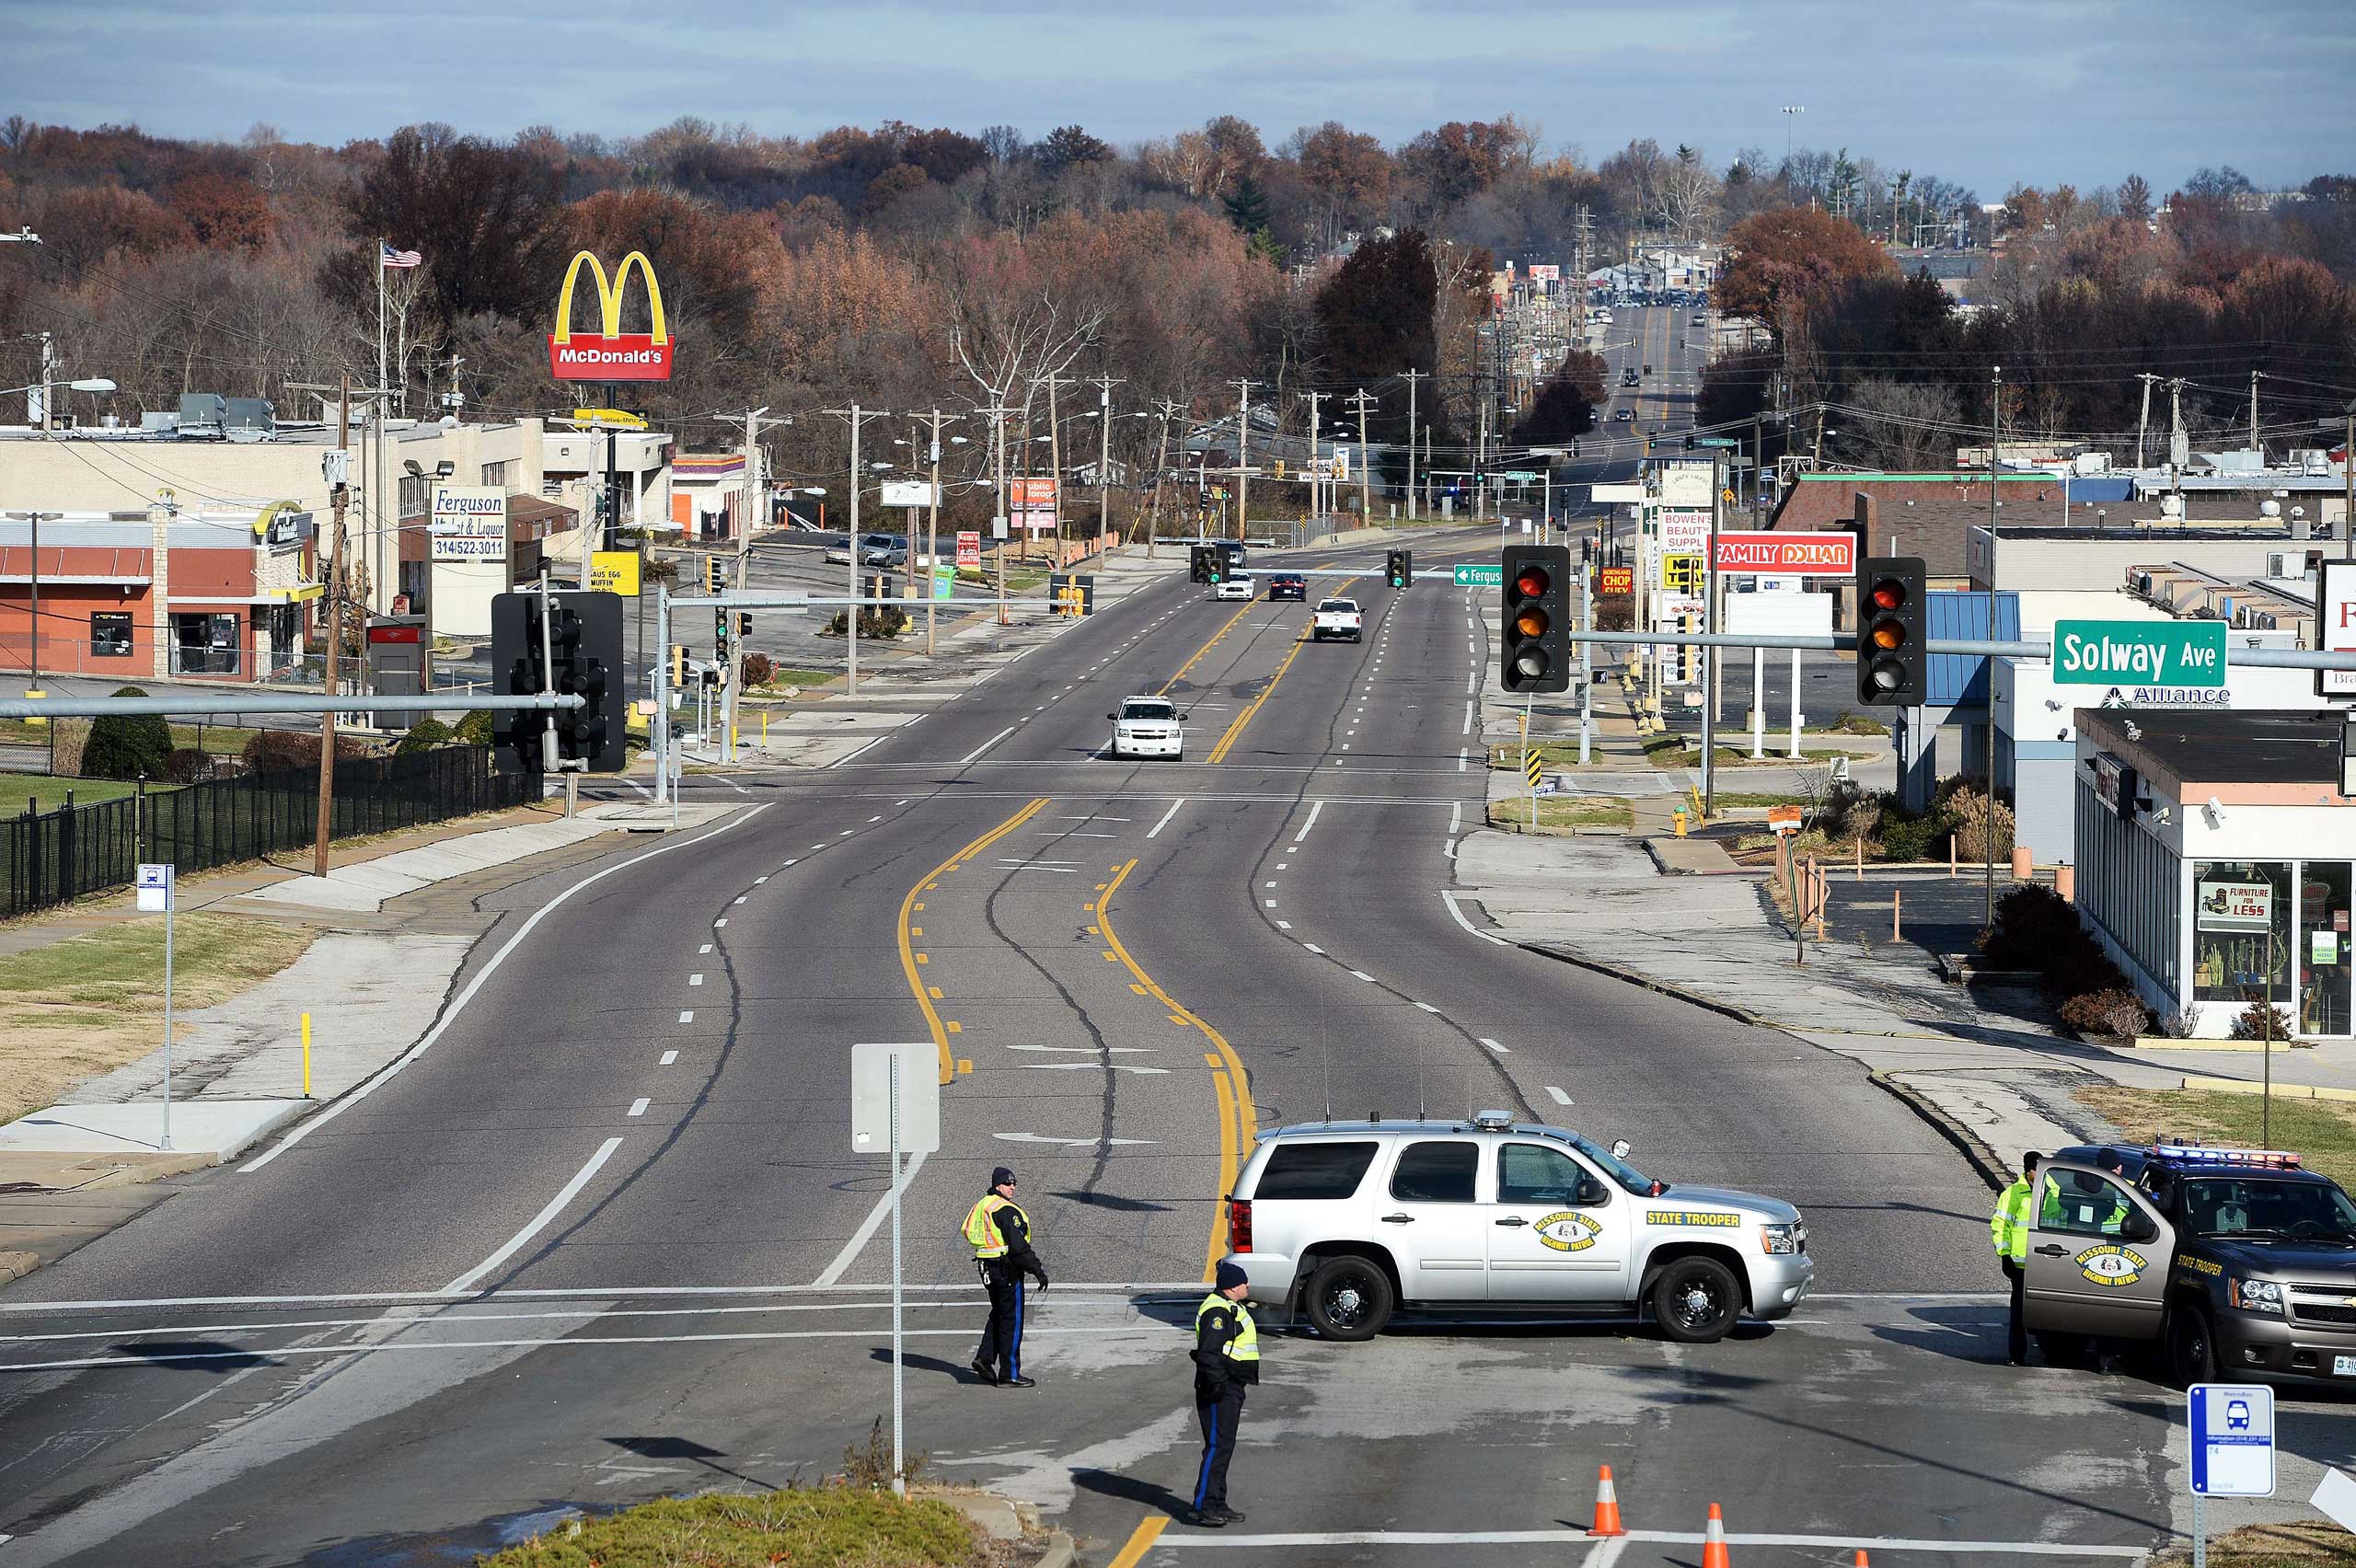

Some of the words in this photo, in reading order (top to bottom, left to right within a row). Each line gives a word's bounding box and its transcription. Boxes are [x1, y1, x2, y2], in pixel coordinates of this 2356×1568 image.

[559, 349, 663, 363] McDonald's
[436, 490, 502, 515] Ferguson
[1665, 515, 1713, 524] BOWEN'S
[467, 517, 474, 535] &
[477, 517, 503, 539] Liquor
[436, 541, 502, 554] 314/522-3011
[1669, 538, 1703, 547] SUPPL
[1717, 544, 1779, 563] FAMILY
[1782, 544, 1848, 564] DOLLAR
[1471, 569, 1502, 585] Fergus
[1603, 575, 1631, 586] CHOP
[2063, 633, 2166, 682] Solway
[2180, 641, 2215, 667] Ave
[2133, 686, 2230, 703] Alliance
[2230, 888, 2269, 898] FURNITURE
[2233, 905, 2265, 917] LESS
[1535, 1212, 1576, 1231] MISSOURI
[1578, 1215, 1601, 1233] STATE
[1647, 1211, 1682, 1225] STATE
[1685, 1213, 1739, 1227] TROOPER
[1542, 1235, 1570, 1251] HIGHWAY
[1571, 1237, 1594, 1251] PATROL
[2075, 1245, 2120, 1264] MISSOURI
[2122, 1249, 2148, 1269] STATE
[2177, 1254, 2194, 1269] STATE
[2195, 1258, 2223, 1276] TROOPER
[2083, 1268, 2113, 1286] HIGHWAY
[2114, 1272, 2140, 1286] PATROL
